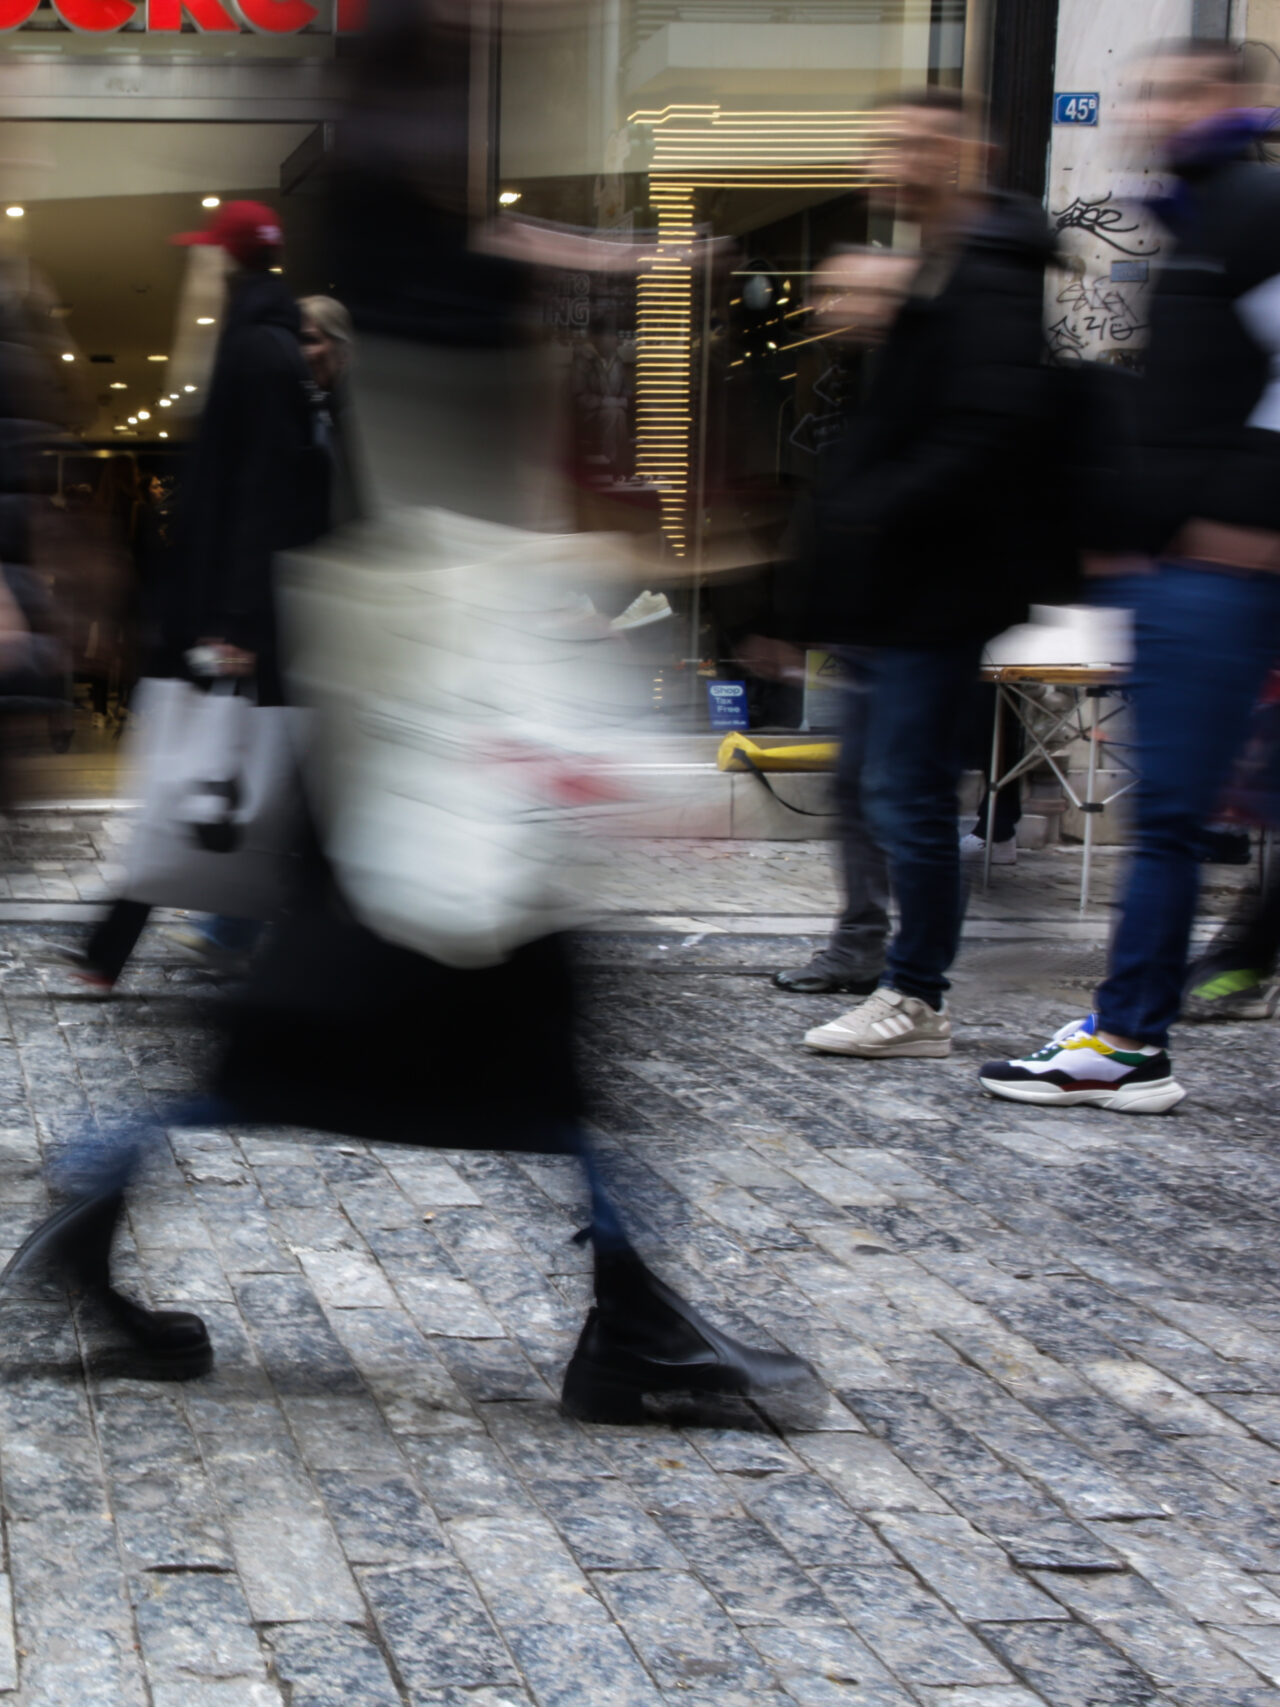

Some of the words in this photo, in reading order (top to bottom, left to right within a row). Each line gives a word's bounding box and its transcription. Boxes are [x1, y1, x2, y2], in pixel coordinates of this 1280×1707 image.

[713, 686, 741, 696] Shop
[714, 697, 732, 705] Tax
[717, 705, 740, 713] Free
